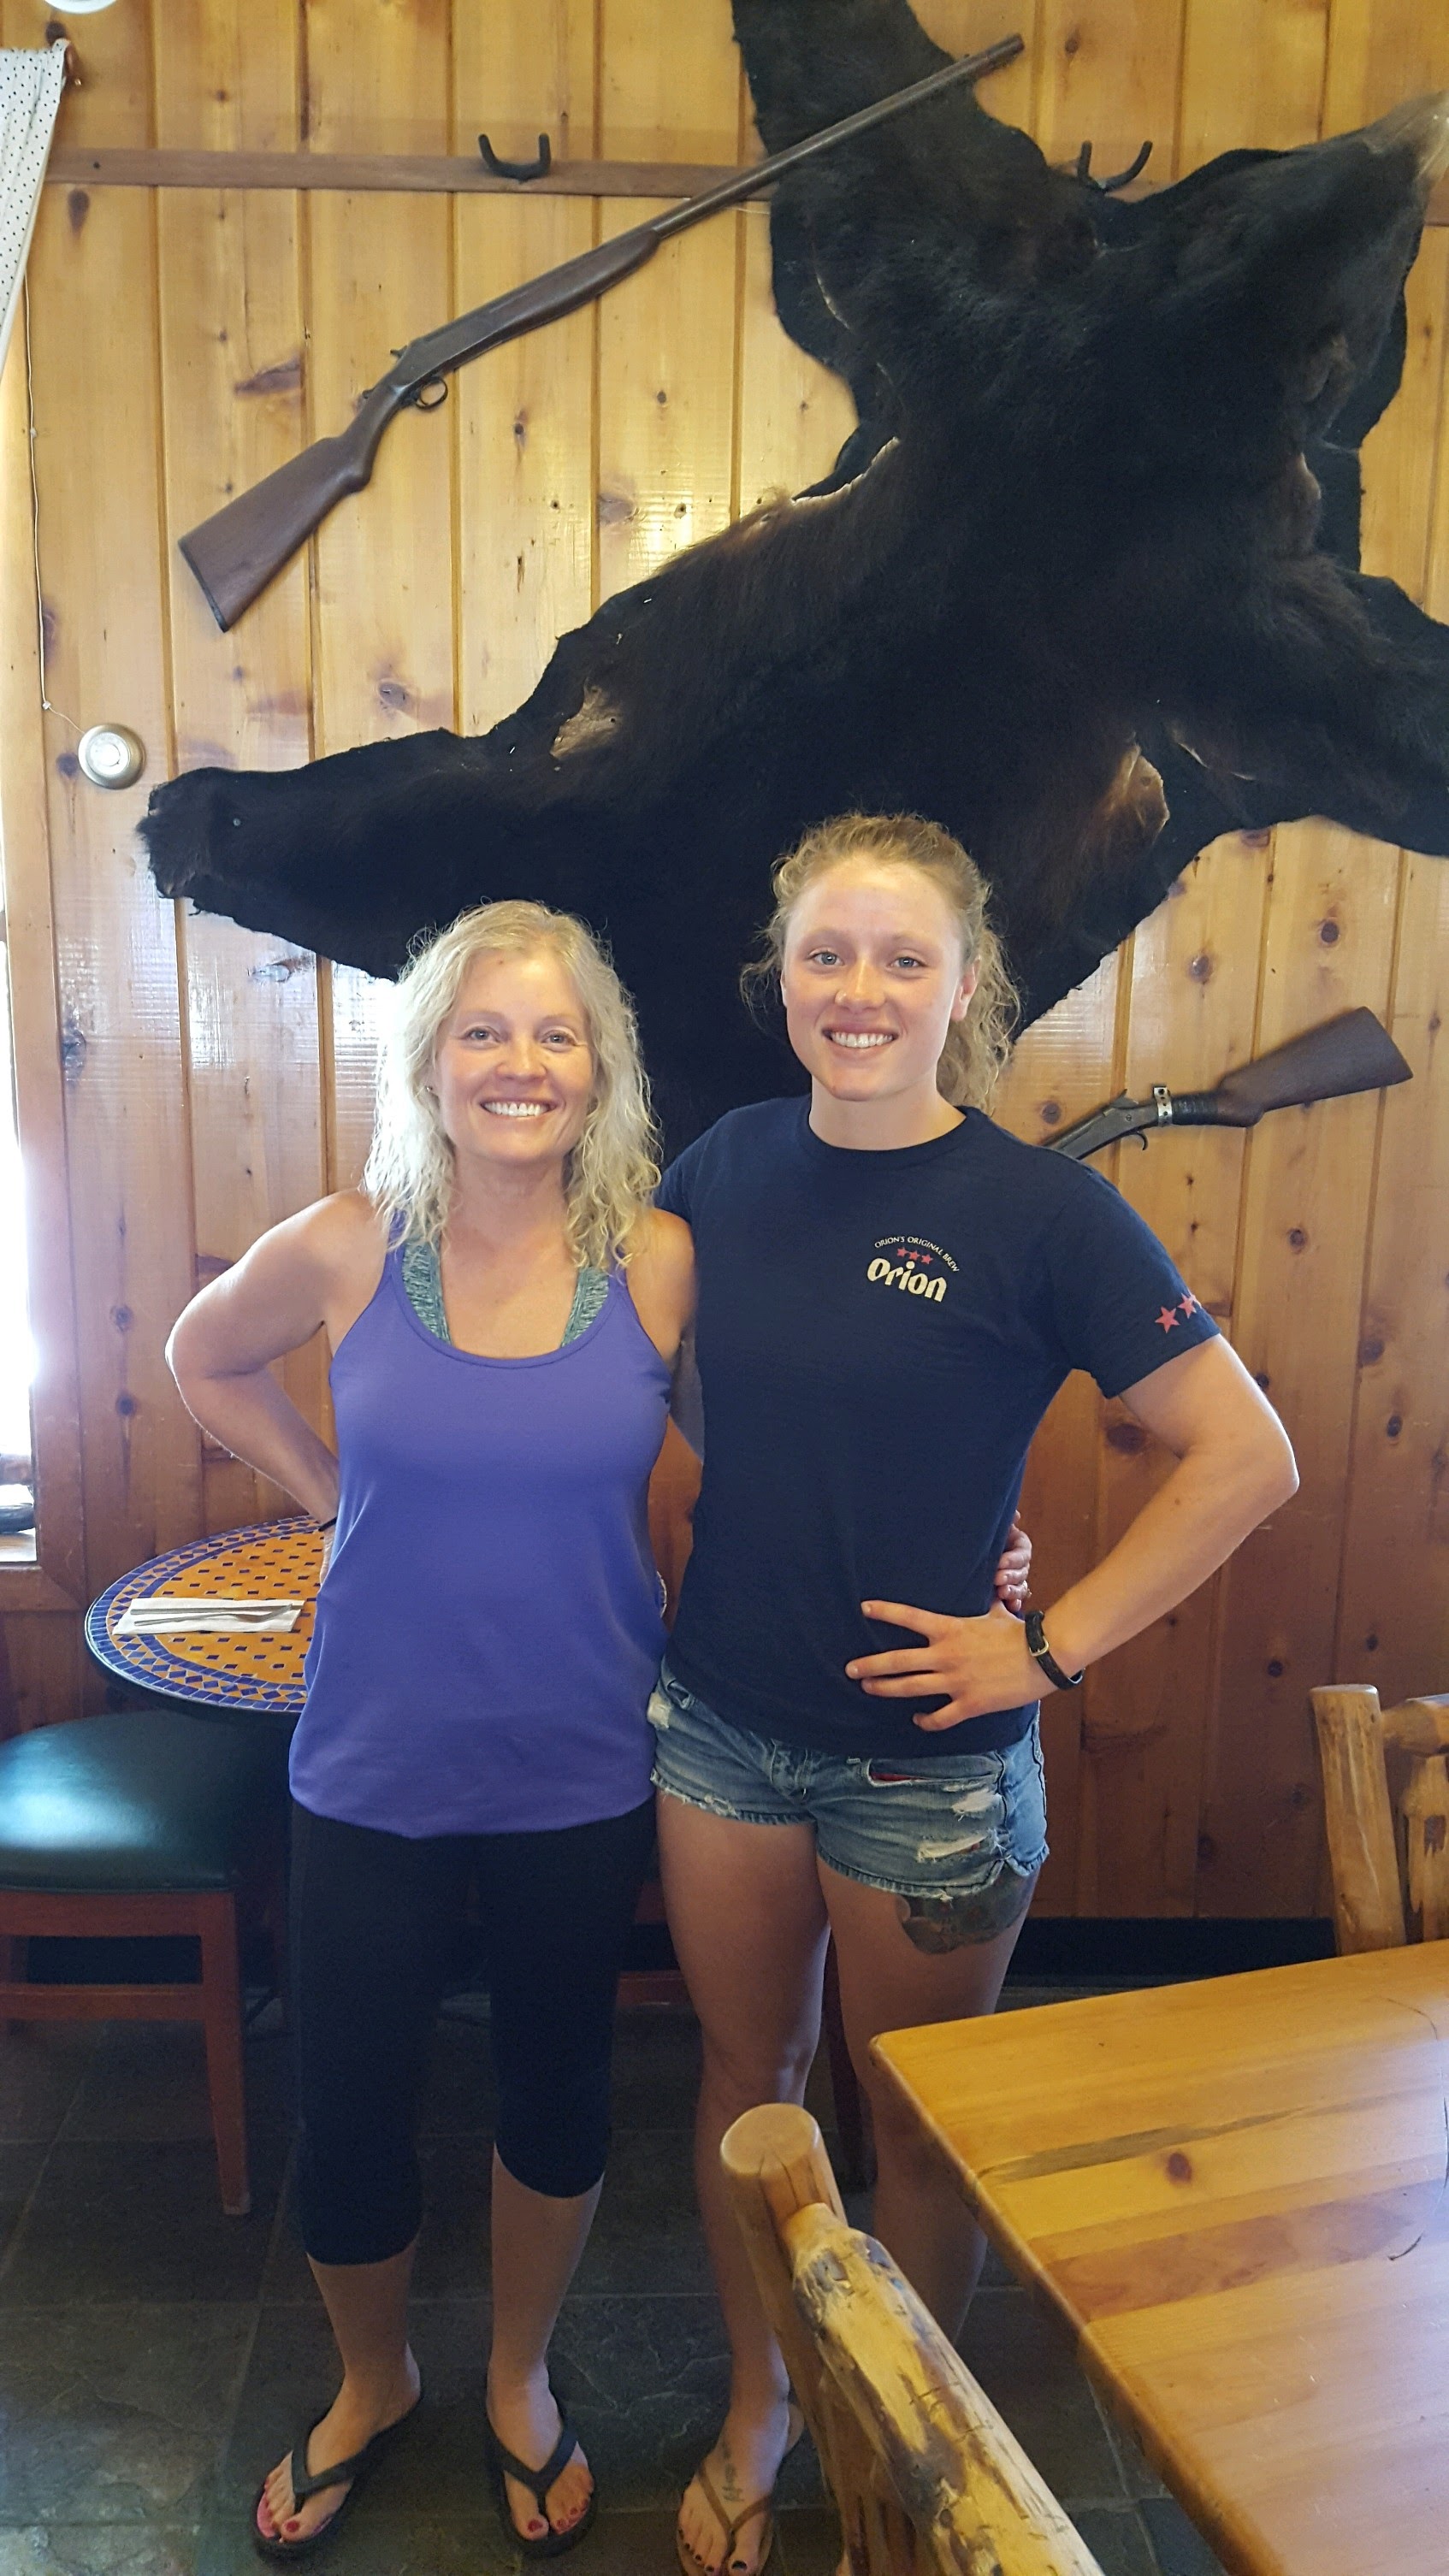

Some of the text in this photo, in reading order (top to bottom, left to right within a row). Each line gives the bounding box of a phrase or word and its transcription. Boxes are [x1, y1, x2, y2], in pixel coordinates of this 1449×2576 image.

[874, 1236, 960, 1272] ORION'S ORIGINAL BREW
[866, 1257, 947, 1303] Orion
